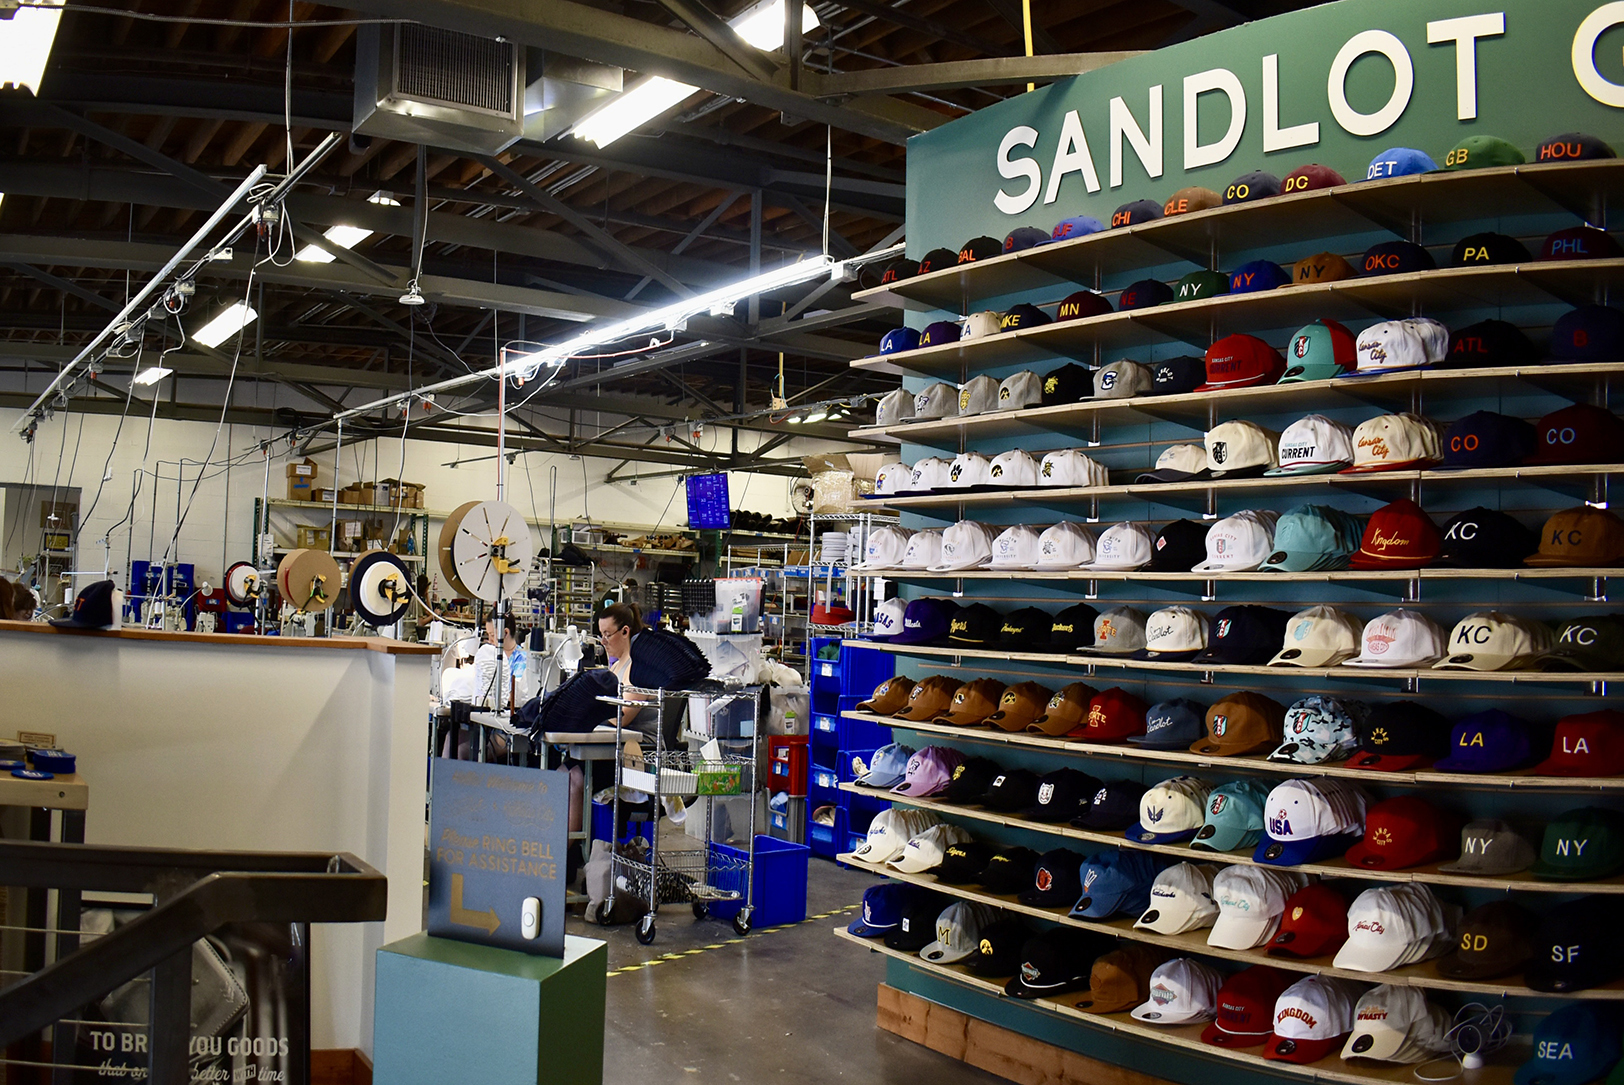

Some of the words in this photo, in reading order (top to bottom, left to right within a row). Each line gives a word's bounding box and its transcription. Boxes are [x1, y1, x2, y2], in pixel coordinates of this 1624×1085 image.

[994, 11, 1506, 215] SANDLOT
[1445, 148, 1469, 167] GB
[1540, 142, 1582, 160] HOU
[1367, 161, 1397, 180] DET
[1226, 184, 1250, 200] CO
[1285, 175, 1309, 192] DC
[1164, 199, 1188, 215] CLE
[1111, 211, 1131, 227] CHI
[1052, 222, 1073, 240] BUF
[1005, 236, 1014, 250] B
[1551, 238, 1588, 256] PHL
[1365, 254, 1400, 271] OKC
[1462, 246, 1490, 262] PA
[881, 269, 898, 284] ATL
[1232, 272, 1255, 289] NY
[1300, 265, 1325, 280] NY
[1179, 283, 1202, 297] NY
[1059, 303, 1080, 318] MN
[881, 338, 893, 352] LA
[919, 331, 931, 346] LA
[1454, 336, 1488, 354] ATL
[1450, 434, 1480, 452] CO
[1546, 427, 1576, 445] CO
[1281, 446, 1315, 459] CURRENT
[1444, 521, 1479, 541] KC
[1551, 530, 1582, 546] KC
[1456, 625, 1491, 644] KC
[1559, 624, 1598, 645] KC
[1370, 727, 1390, 742] KANSAS
[1459, 732, 1484, 747] LA
[1562, 736, 1589, 754] LA
[1269, 817, 1293, 835] USA
[1372, 827, 1392, 843] KANSAS
[482, 835, 517, 854] RING
[521, 840, 554, 860] BELL
[1464, 837, 1493, 854] NY
[1556, 838, 1588, 856] NY
[436, 846, 465, 865] FOR
[468, 852, 557, 880] ASSISTANCE
[1460, 932, 1488, 951] SD
[1551, 945, 1580, 963] SF
[1276, 1007, 1317, 1029] KINGDOM
[90, 1031, 116, 1051] TO
[189, 1035, 222, 1056] YOU
[227, 1037, 289, 1057] GOODS
[1537, 1041, 1573, 1060] SEA
[98, 1058, 127, 1077] that
[257, 1066, 285, 1081] time
